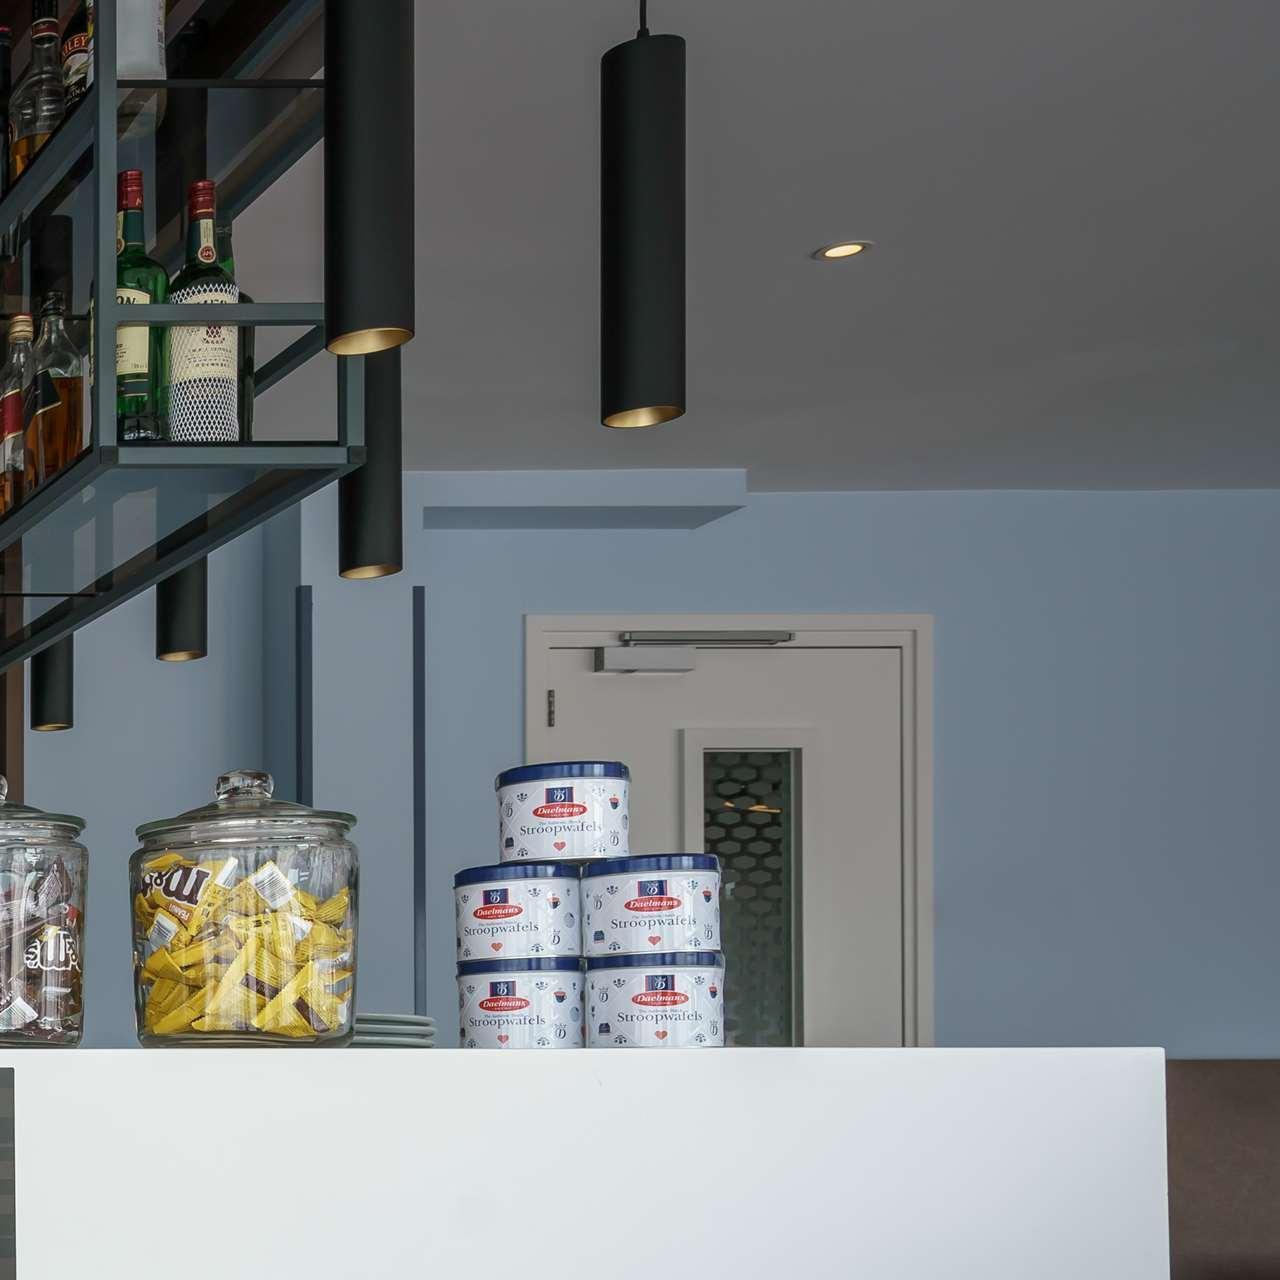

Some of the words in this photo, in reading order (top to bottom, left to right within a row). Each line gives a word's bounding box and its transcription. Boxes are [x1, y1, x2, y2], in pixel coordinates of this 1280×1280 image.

[520, 822, 602, 836] Stroopwafels
[463, 923, 539, 937] Stroopwafels
[611, 917, 696, 930] Stroopwafels
[469, 1015, 546, 1029] Stroopwafels
[617, 1011, 703, 1024] Stroopwafels
